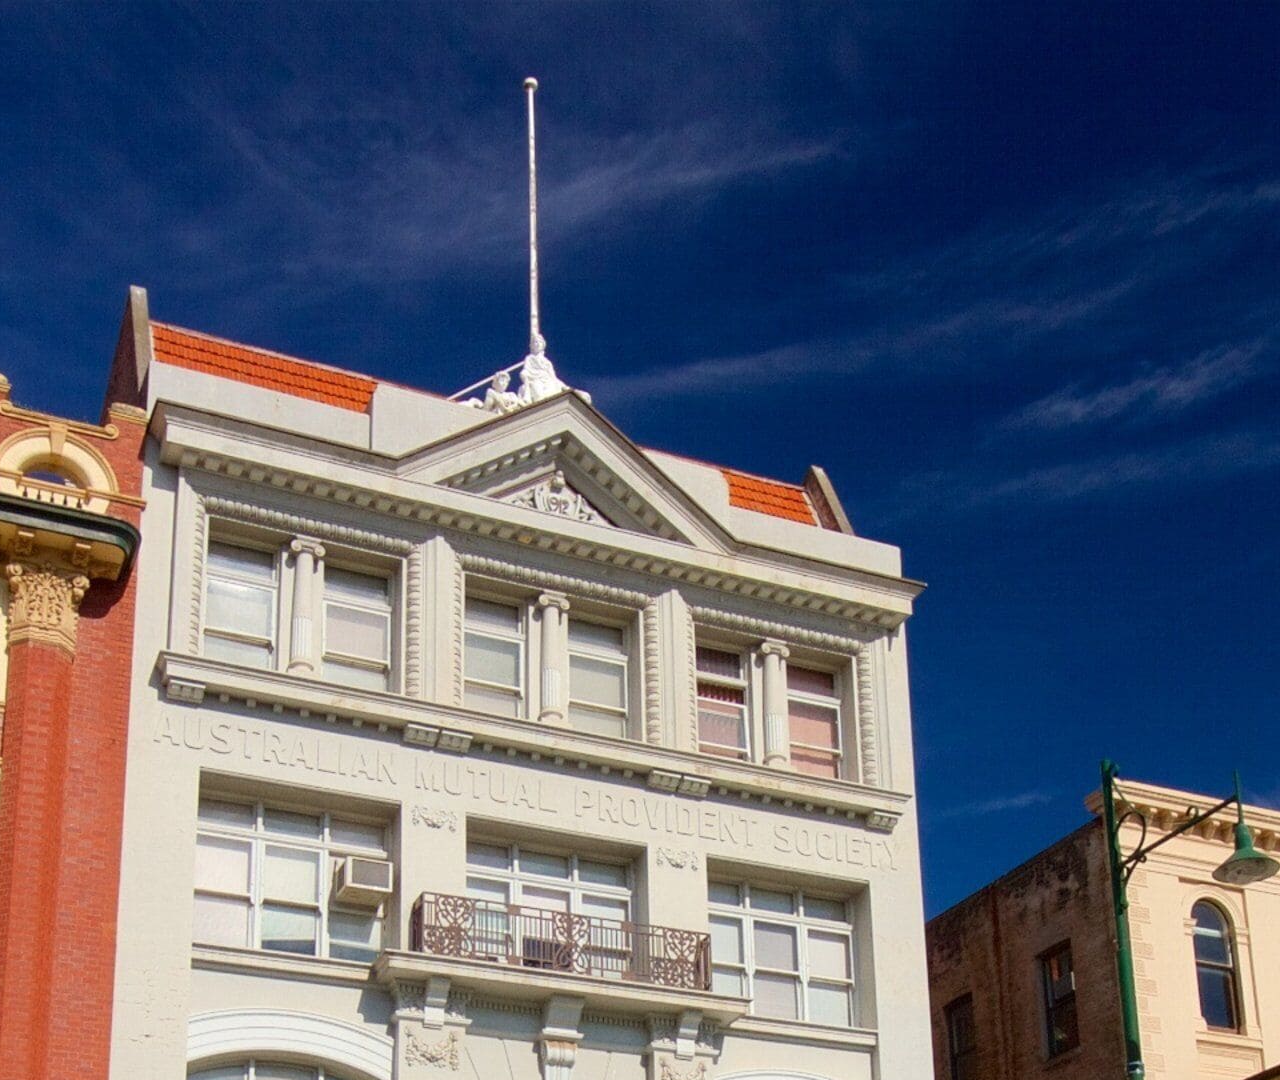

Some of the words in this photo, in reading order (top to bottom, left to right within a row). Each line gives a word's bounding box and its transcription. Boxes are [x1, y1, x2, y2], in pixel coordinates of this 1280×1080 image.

[153, 708, 398, 786] AUSTRALIAN
[414, 755, 558, 814] MUTUAL
[574, 783, 758, 848] PROVIDENT
[773, 824, 900, 872] SOCIETY
